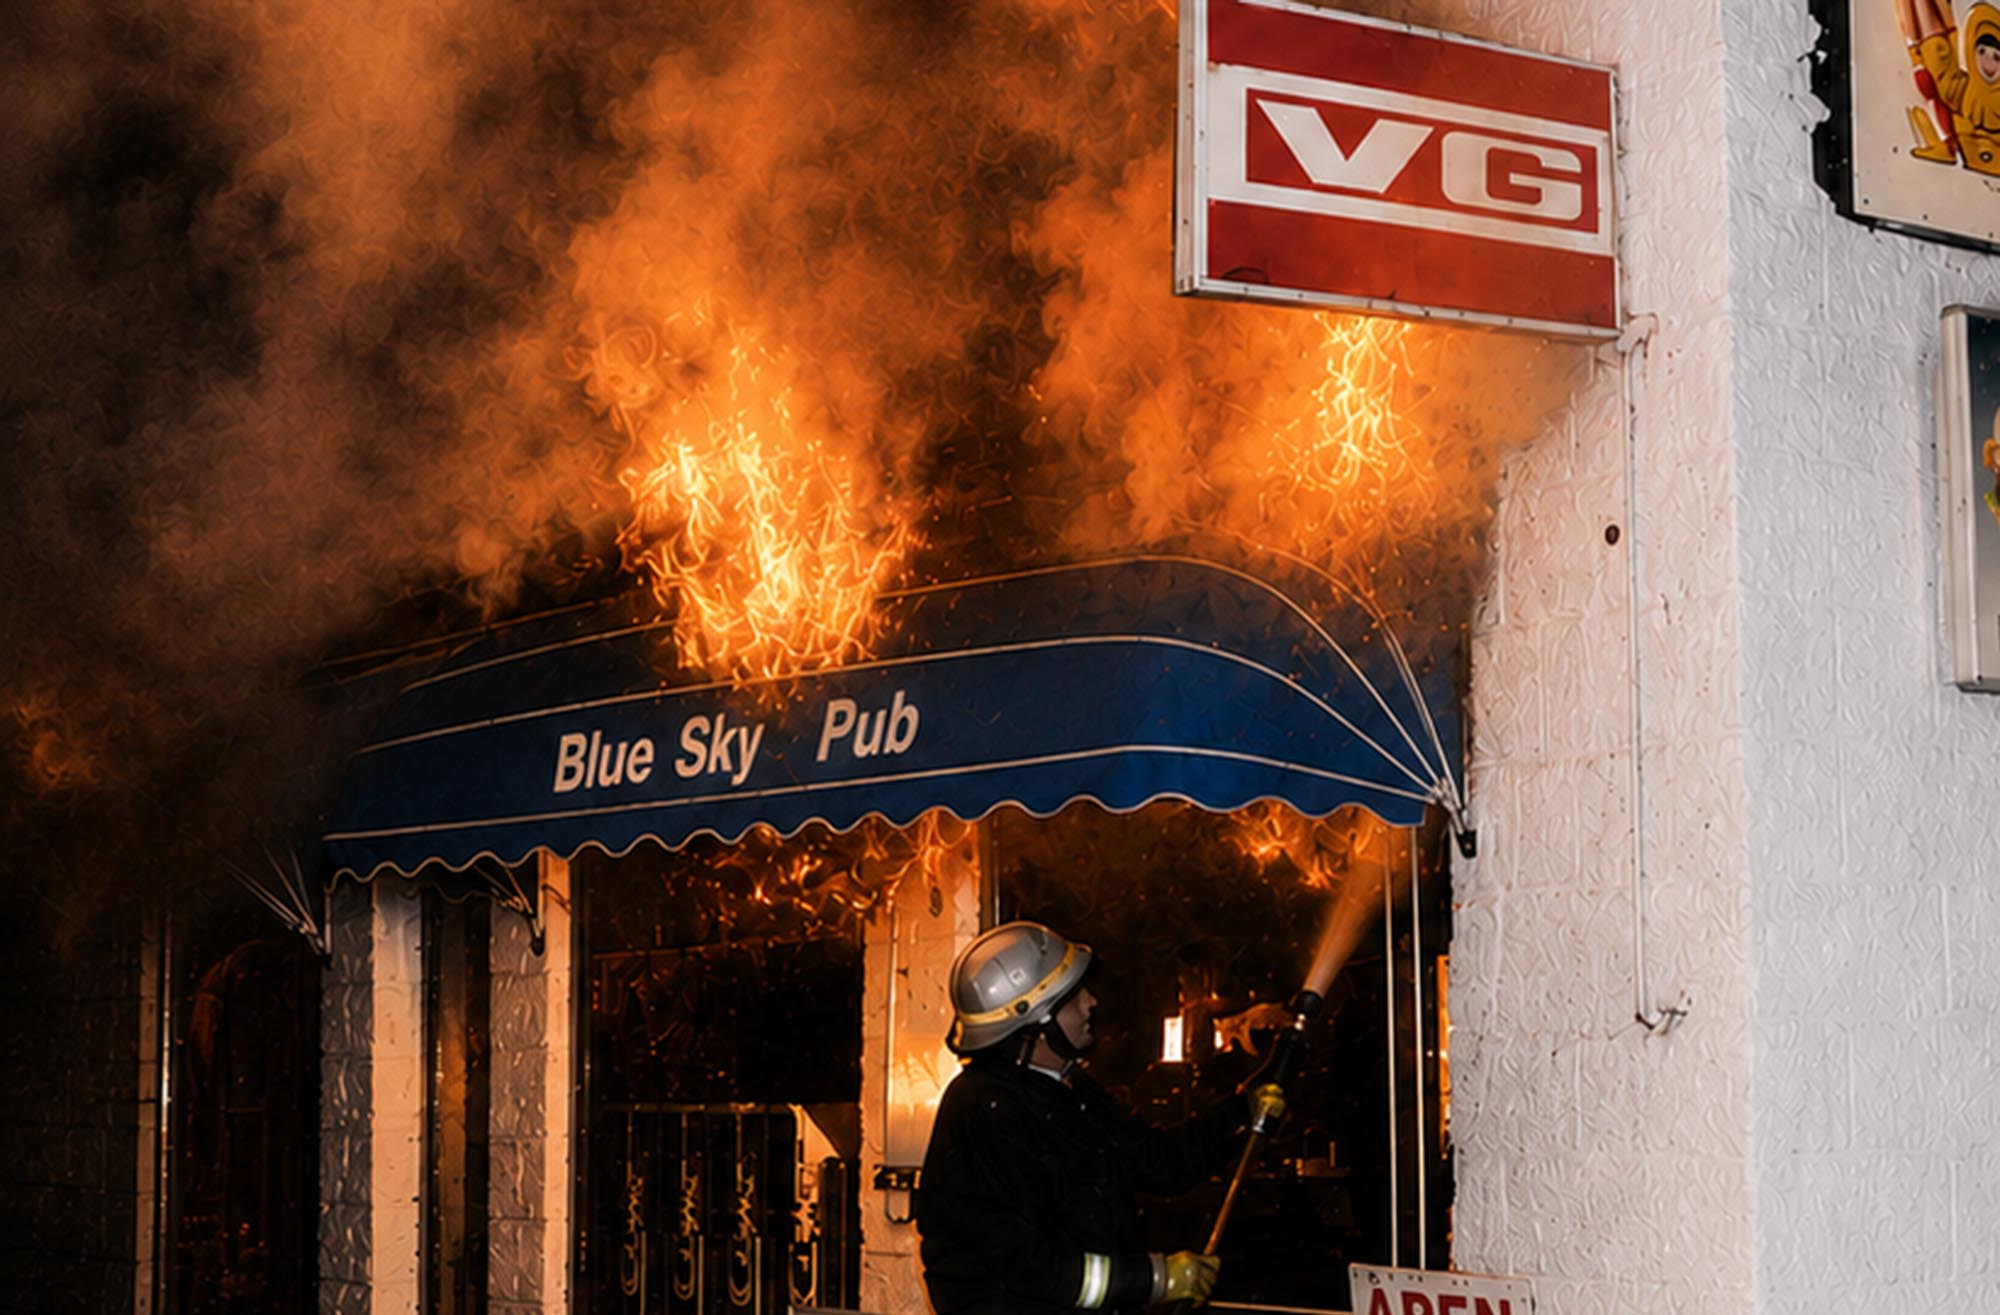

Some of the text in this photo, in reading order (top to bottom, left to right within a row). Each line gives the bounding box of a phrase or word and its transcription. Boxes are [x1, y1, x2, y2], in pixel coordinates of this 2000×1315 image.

[1256, 98, 1582, 222] VG
[553, 690, 920, 793] Blue Sky Pub
